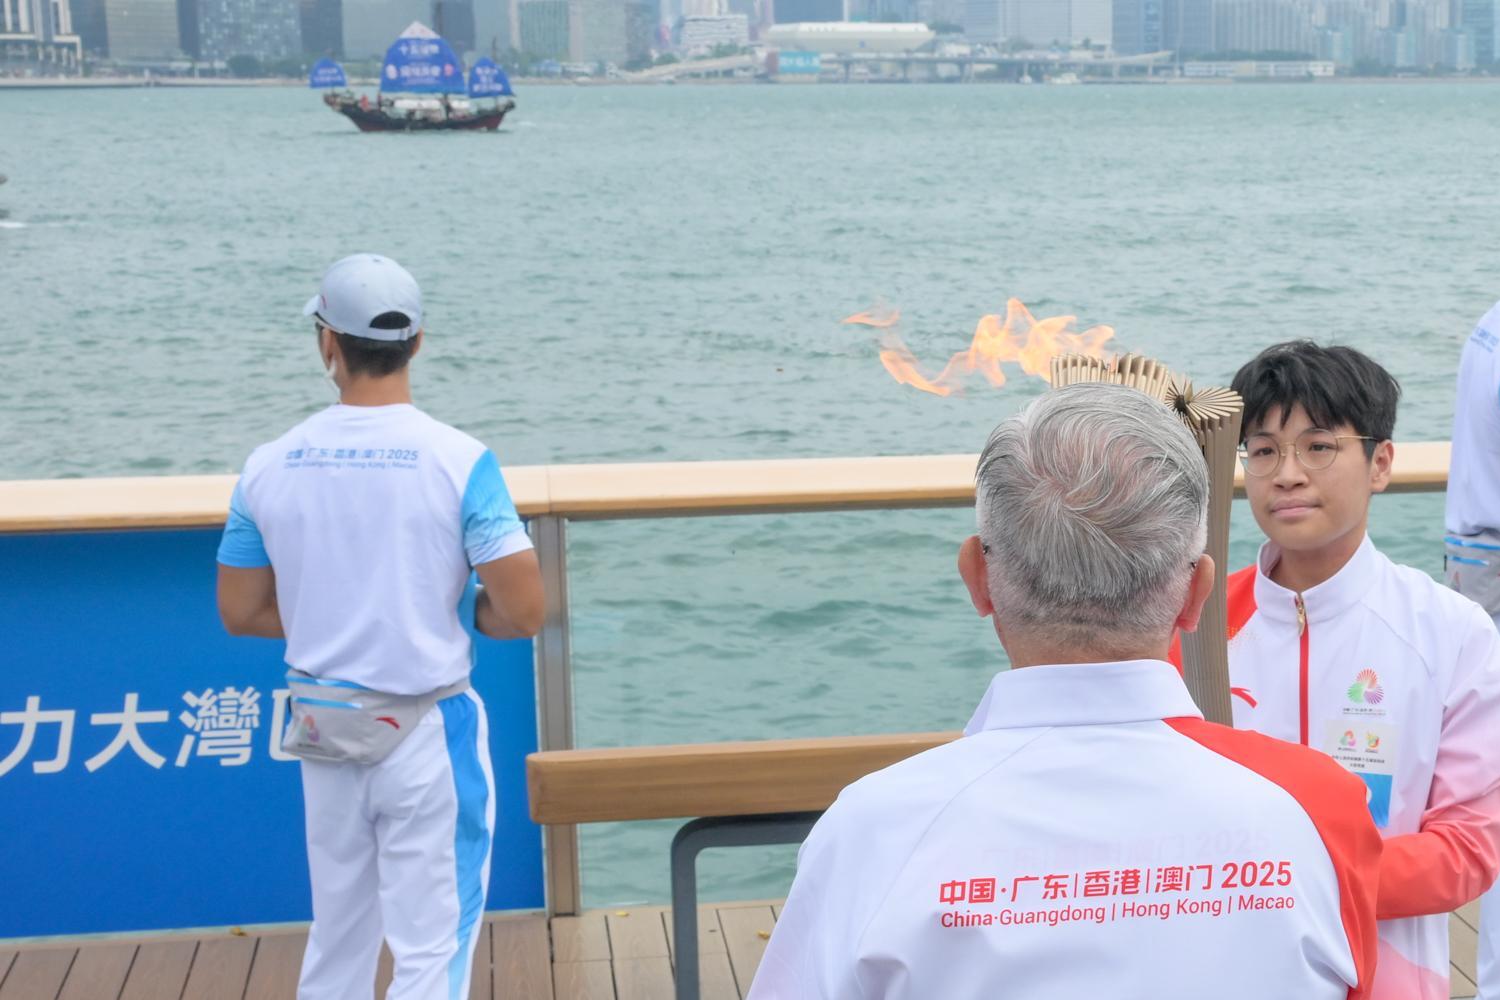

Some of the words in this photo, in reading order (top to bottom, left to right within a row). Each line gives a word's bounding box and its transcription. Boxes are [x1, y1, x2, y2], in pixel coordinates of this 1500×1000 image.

[386, 448, 419, 460] 2025
[1221, 861, 1293, 889] 2025
[1122, 901, 1171, 920] Hong
[1176, 897, 1222, 916] Kong
[1238, 893, 1295, 911] Macao
